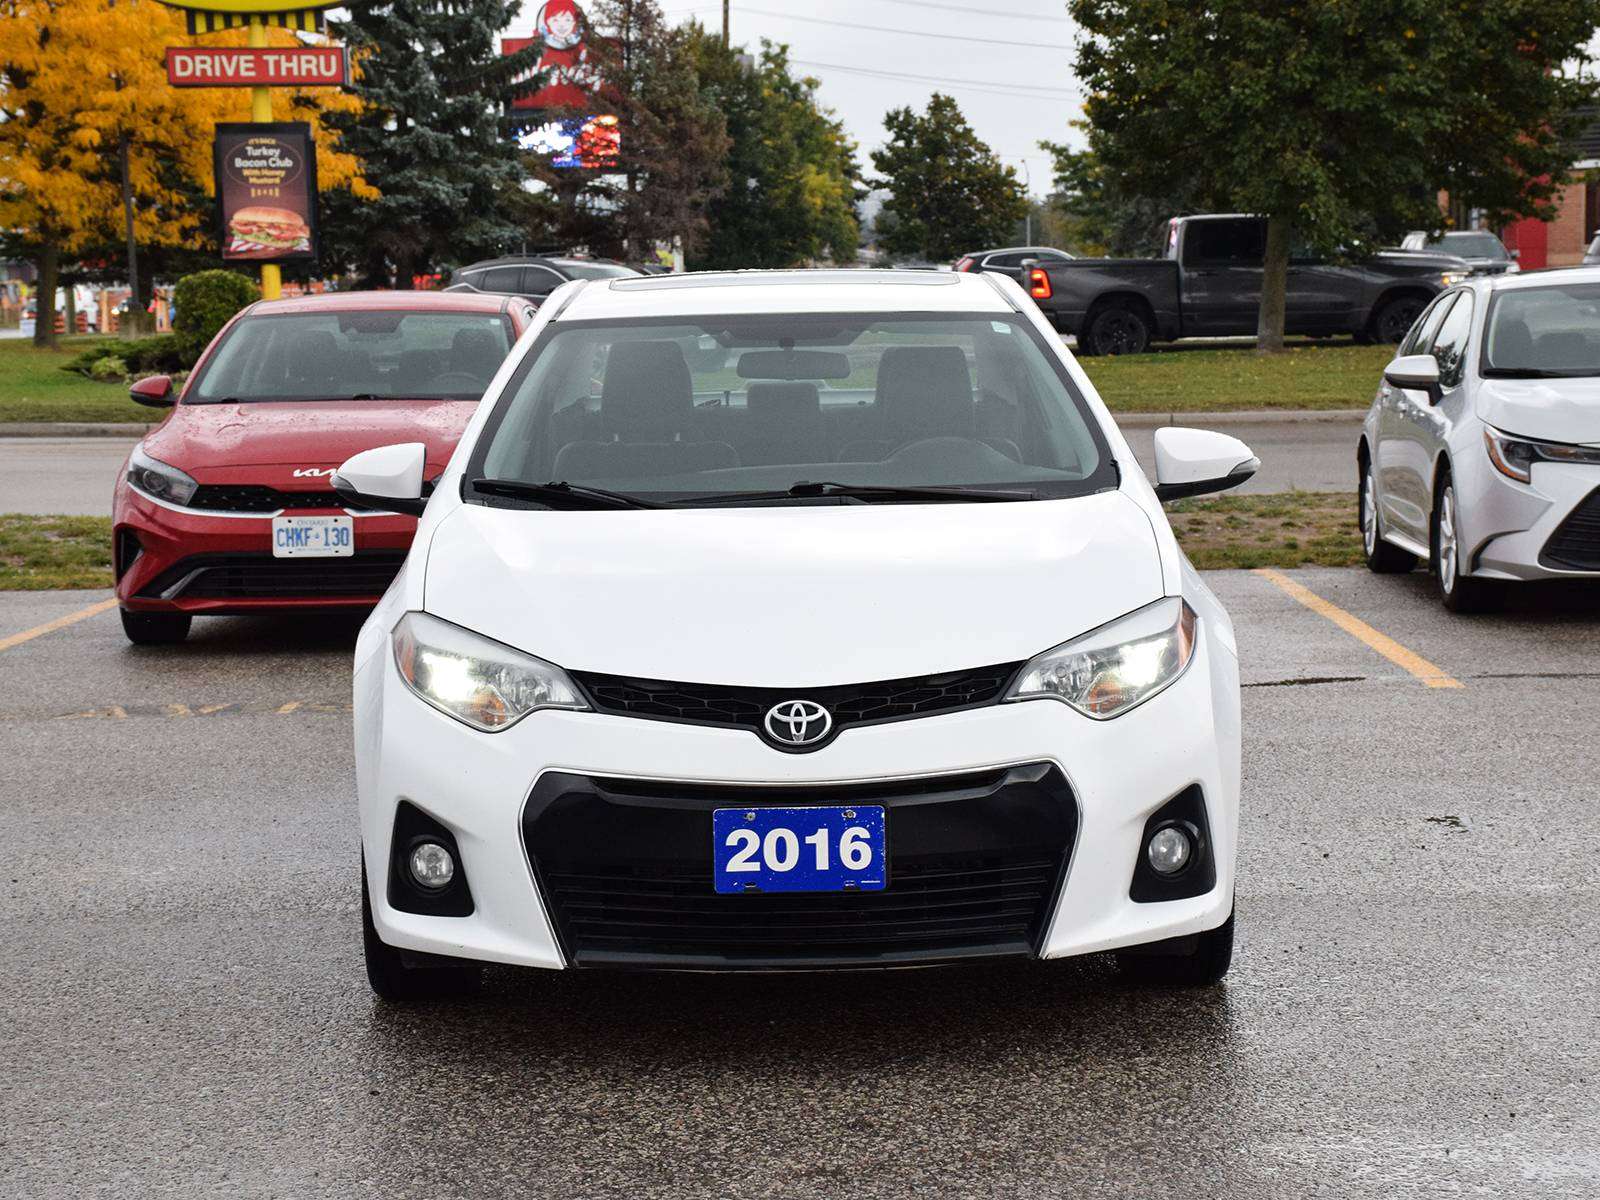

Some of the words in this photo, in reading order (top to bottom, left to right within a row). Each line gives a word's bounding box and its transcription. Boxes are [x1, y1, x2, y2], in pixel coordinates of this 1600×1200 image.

[174, 55, 256, 77] DRIVE
[263, 54, 337, 77] THRU
[245, 146, 281, 158] Turkey
[234, 157, 268, 168] Bacon
[268, 156, 294, 168] Club
[725, 826, 873, 872] 2016
